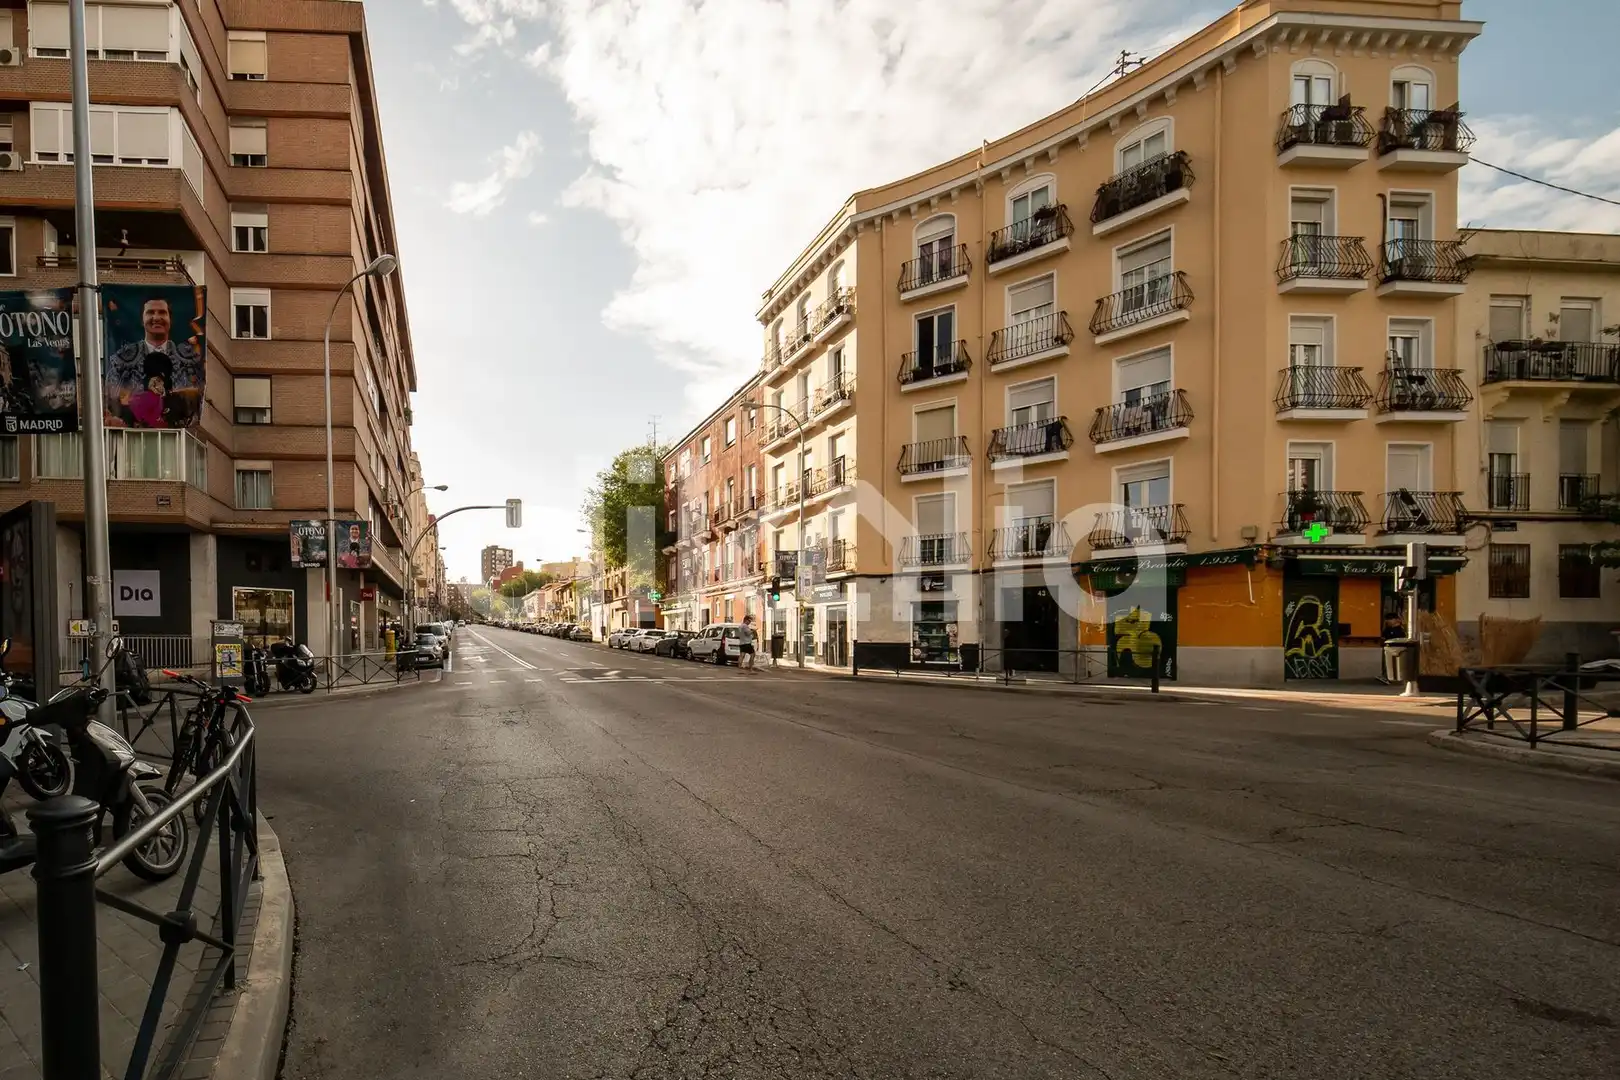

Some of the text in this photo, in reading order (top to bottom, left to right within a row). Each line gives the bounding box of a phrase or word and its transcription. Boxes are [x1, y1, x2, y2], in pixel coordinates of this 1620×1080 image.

[20, 419, 63, 431] MADRID
[1091, 562, 1121, 573] Casa
[1342, 562, 1368, 573] Casa
